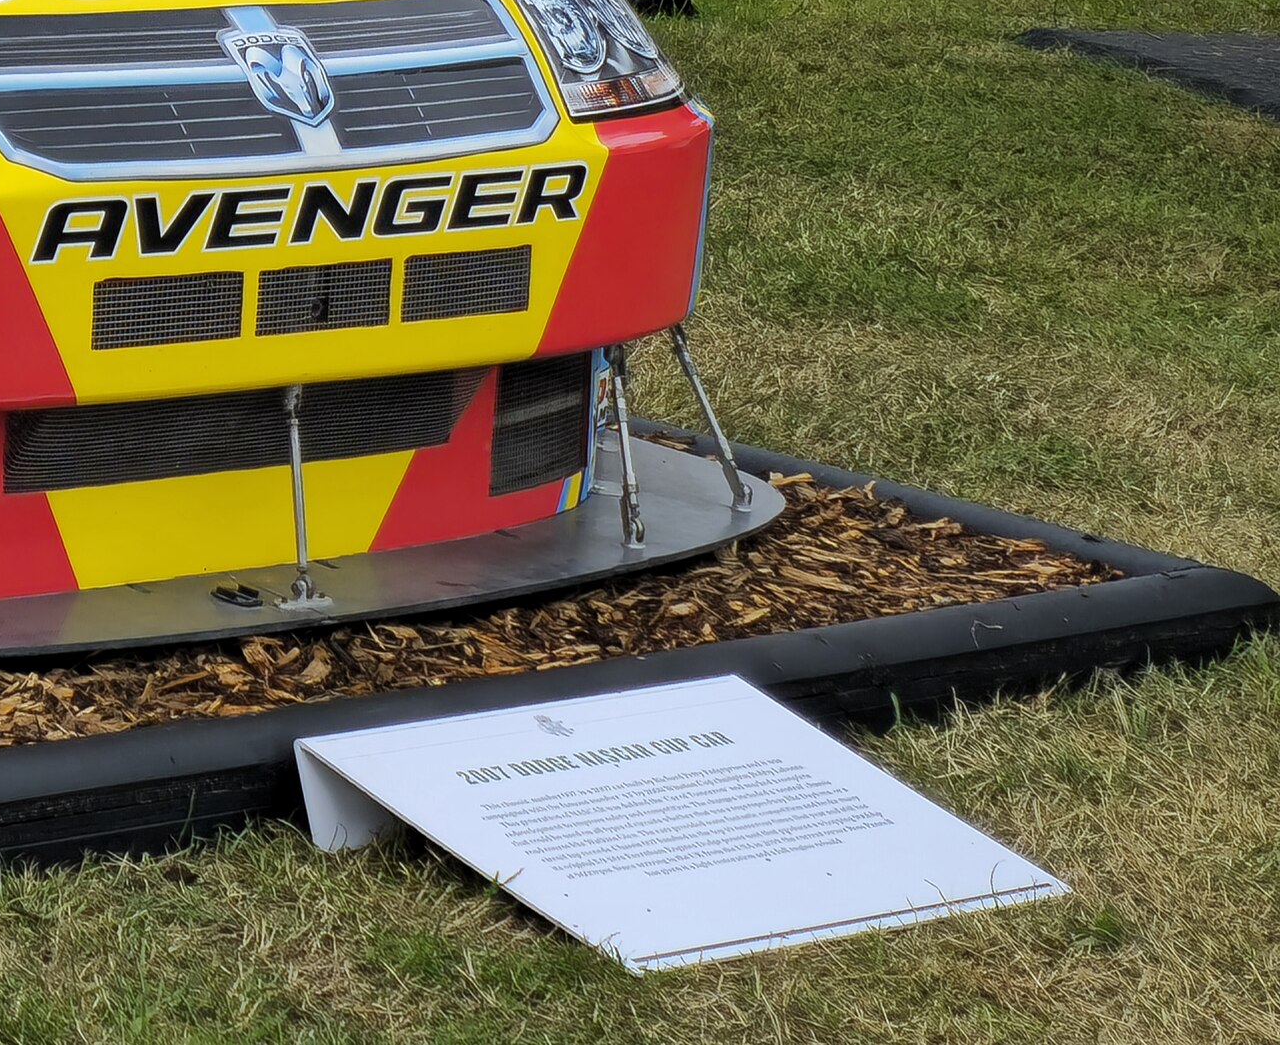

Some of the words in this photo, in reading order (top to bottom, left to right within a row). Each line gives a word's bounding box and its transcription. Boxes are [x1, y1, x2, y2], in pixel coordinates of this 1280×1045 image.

[231, 34, 300, 47] DODGE
[32, 162, 589, 263] AVENGER
[456, 765, 512, 785] 2007
[508, 754, 580, 777] DODGE
[573, 742, 657, 766] NASCAR
[648, 737, 691, 755] CUP
[688, 730, 735, 748] CAR
